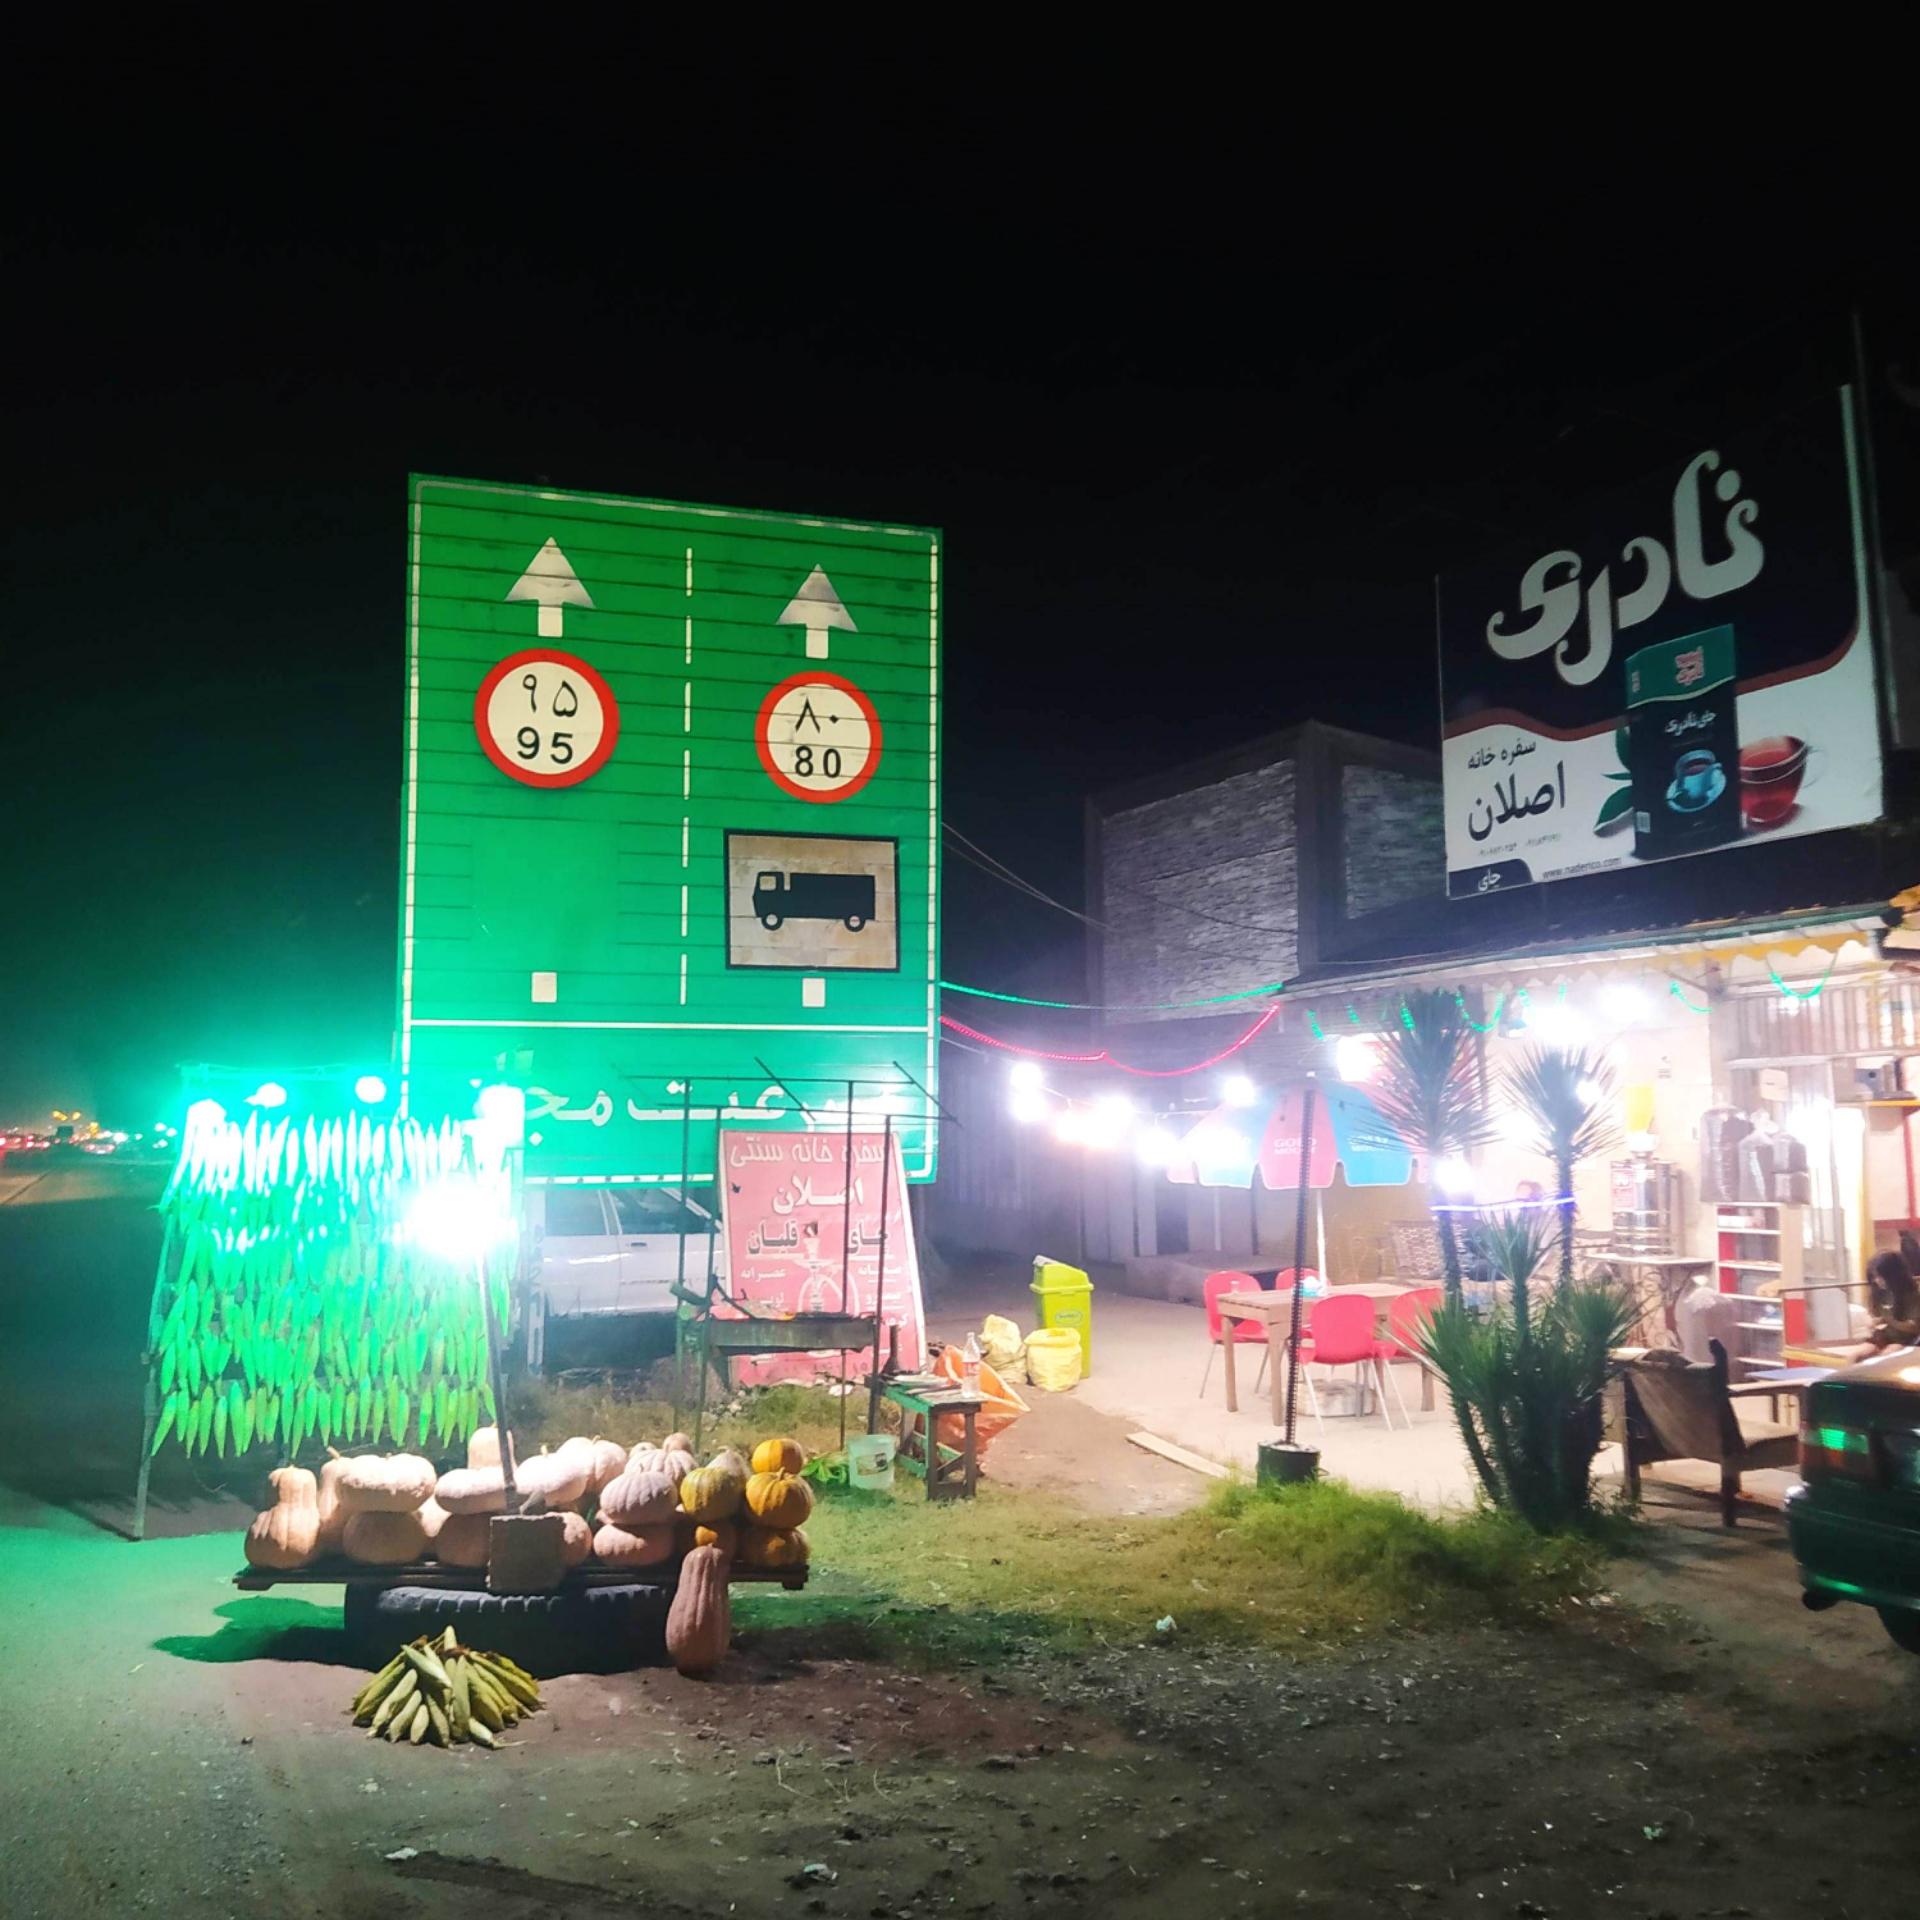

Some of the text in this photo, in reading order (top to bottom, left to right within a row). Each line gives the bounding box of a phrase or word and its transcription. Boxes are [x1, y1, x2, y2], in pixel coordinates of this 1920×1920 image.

[1486, 450, 1765, 686] نادری
[521, 674, 579, 718] ۹۵
[794, 697, 840, 734] ۸۰
[516, 726, 575, 765] 95
[794, 745, 843, 779] 80
[1467, 738, 1537, 770] سفره خانه
[1468, 760, 1566, 841] اصلان
[730, 1135, 885, 1168] سفره خانه سنتی
[773, 1172, 864, 1214] اصلان
[747, 1217, 799, 1255] قلیان
[740, 1266, 787, 1283] عصرانه
